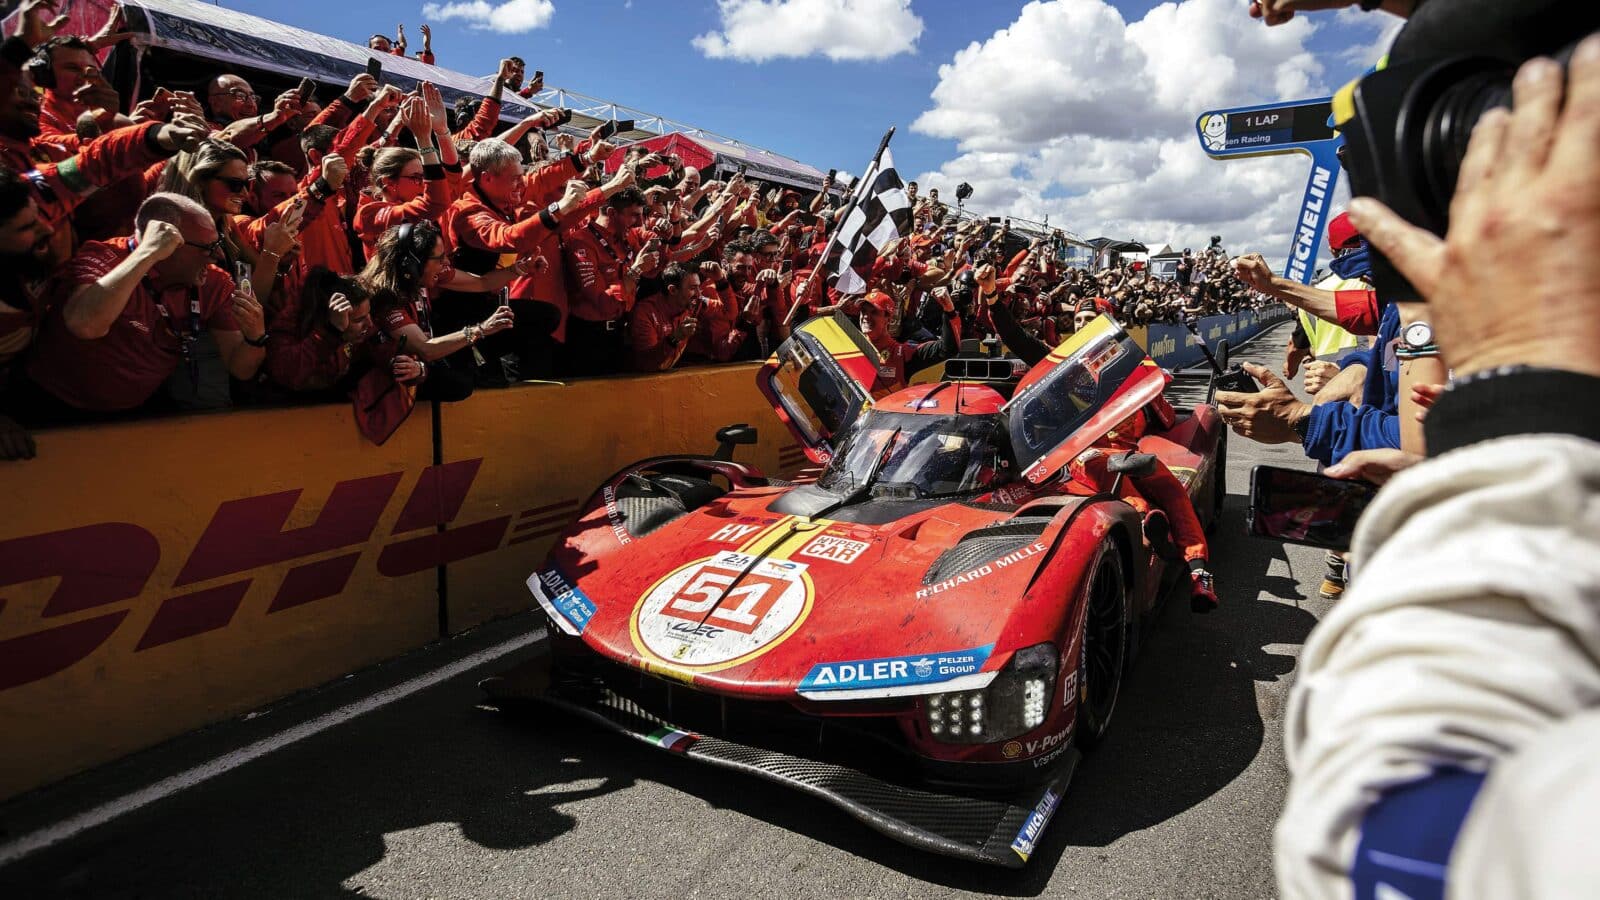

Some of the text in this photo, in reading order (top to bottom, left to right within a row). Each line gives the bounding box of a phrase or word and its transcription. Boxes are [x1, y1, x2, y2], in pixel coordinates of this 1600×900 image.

[1245, 114, 1279, 127] 1 LAP
[1241, 134, 1271, 145] Racing
[1028, 465, 1048, 484] SYS
[707, 523, 762, 543] HY
[806, 543, 857, 562] CAR
[816, 535, 866, 551] HYPER
[0, 457, 513, 691] DHL
[915, 541, 1047, 600] RICHARD MILLE
[540, 569, 575, 603] ADLER
[670, 571, 773, 626] 51
[671, 621, 725, 639] WEC
[938, 655, 975, 665] PELZER
[812, 659, 908, 686] ADLER
[939, 665, 976, 675] GROUP
[1025, 791, 1056, 841] MICHELIN
